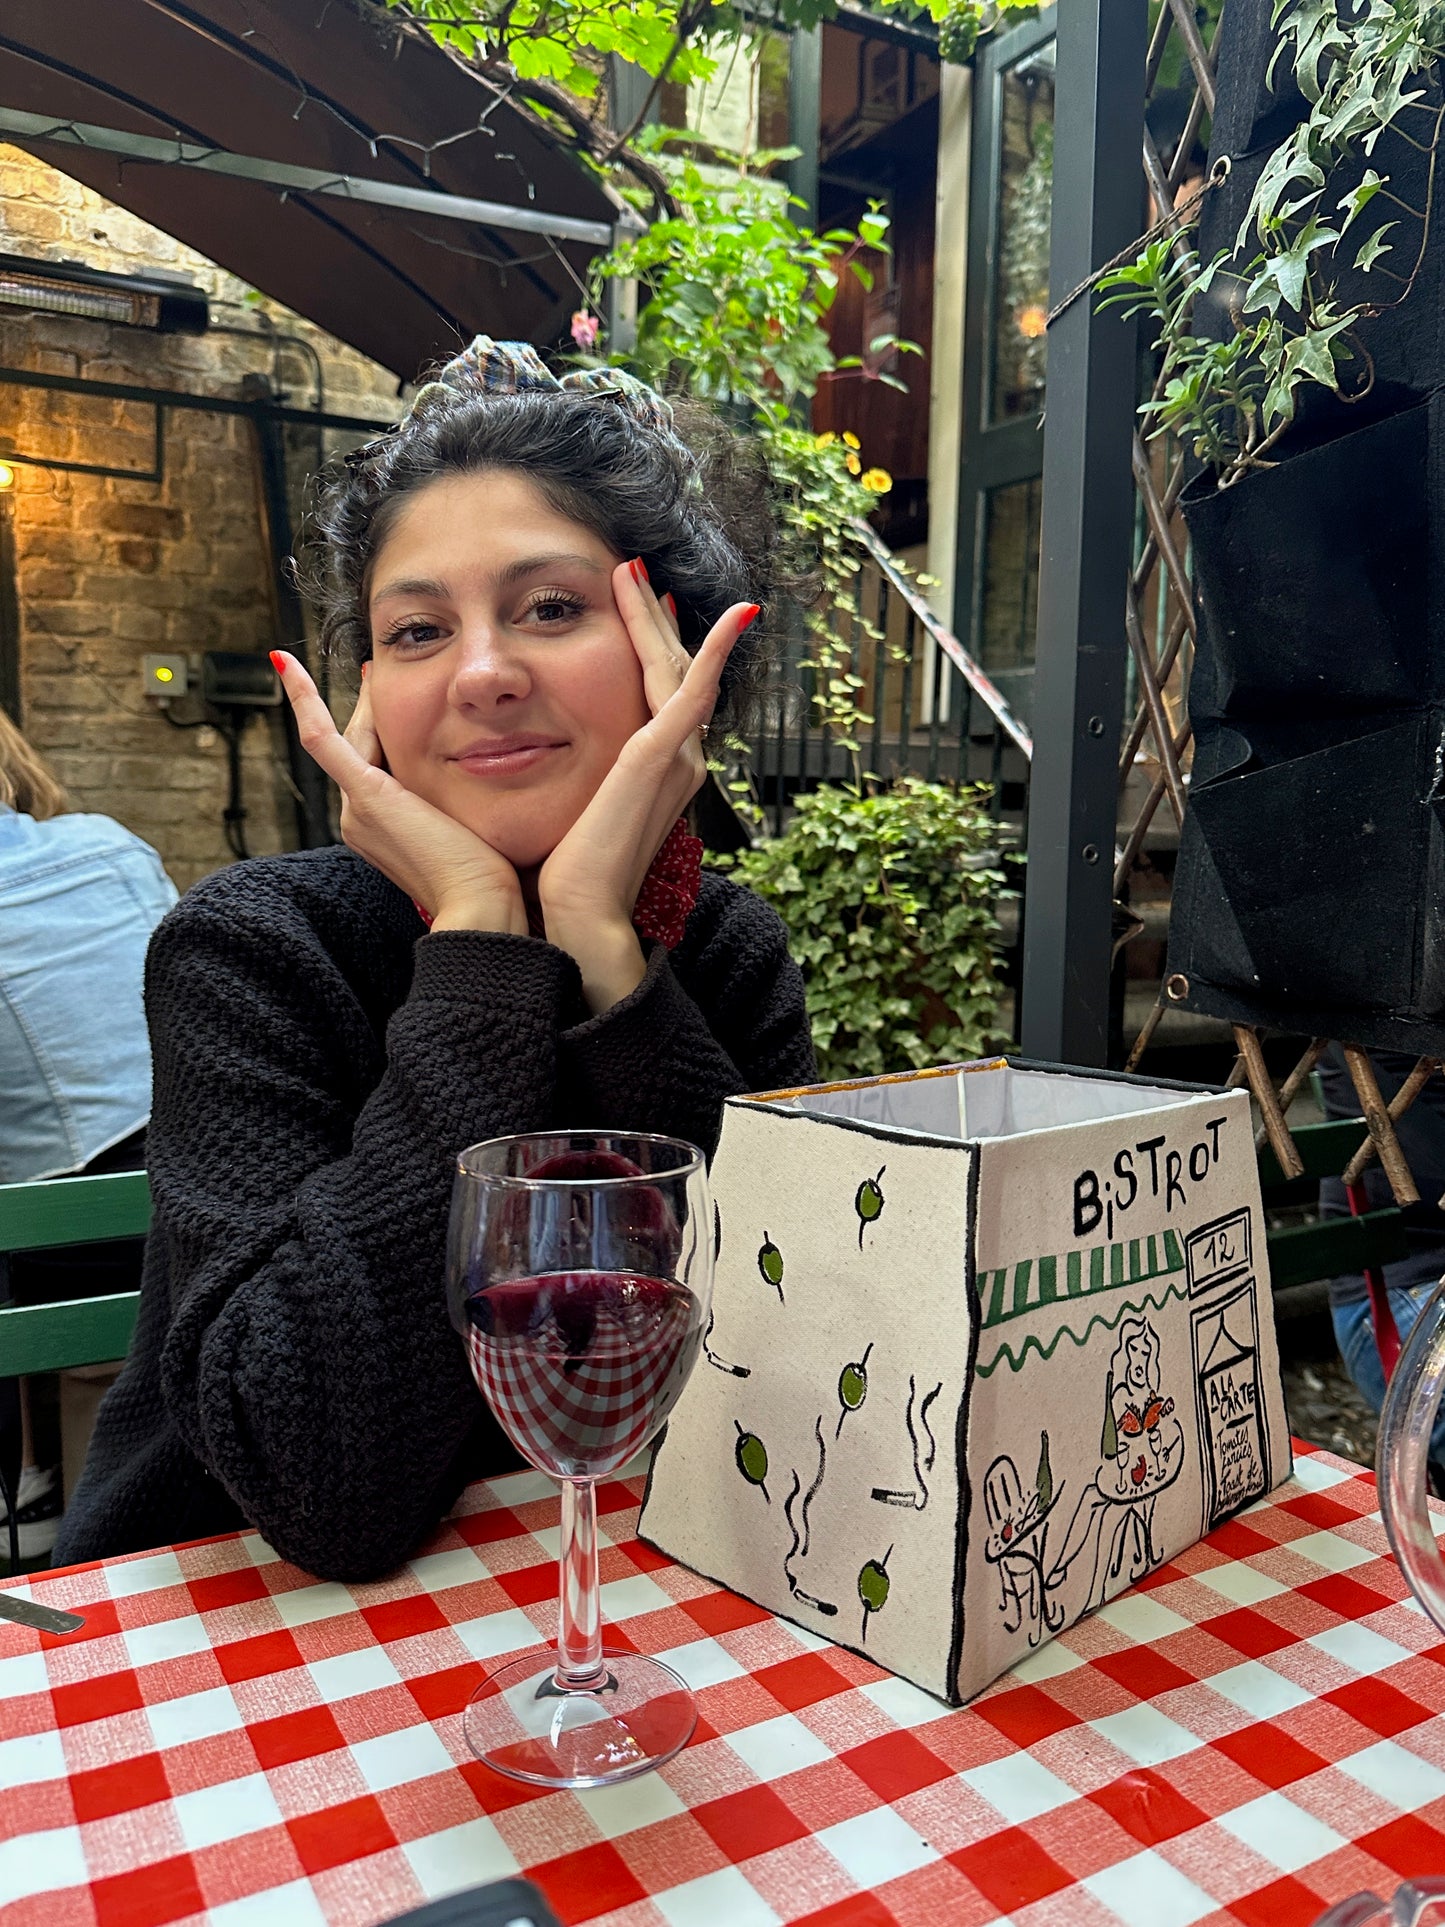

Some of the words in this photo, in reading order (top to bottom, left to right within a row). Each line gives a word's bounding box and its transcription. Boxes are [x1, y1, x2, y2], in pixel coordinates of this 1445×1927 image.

[1074, 1117, 1227, 1240] BiSTROT
[1204, 1232, 1235, 1268] 12
[1210, 1379, 1220, 1406] A
[1221, 1372, 1234, 1396] LA
[1221, 1382, 1255, 1421] CARTE
